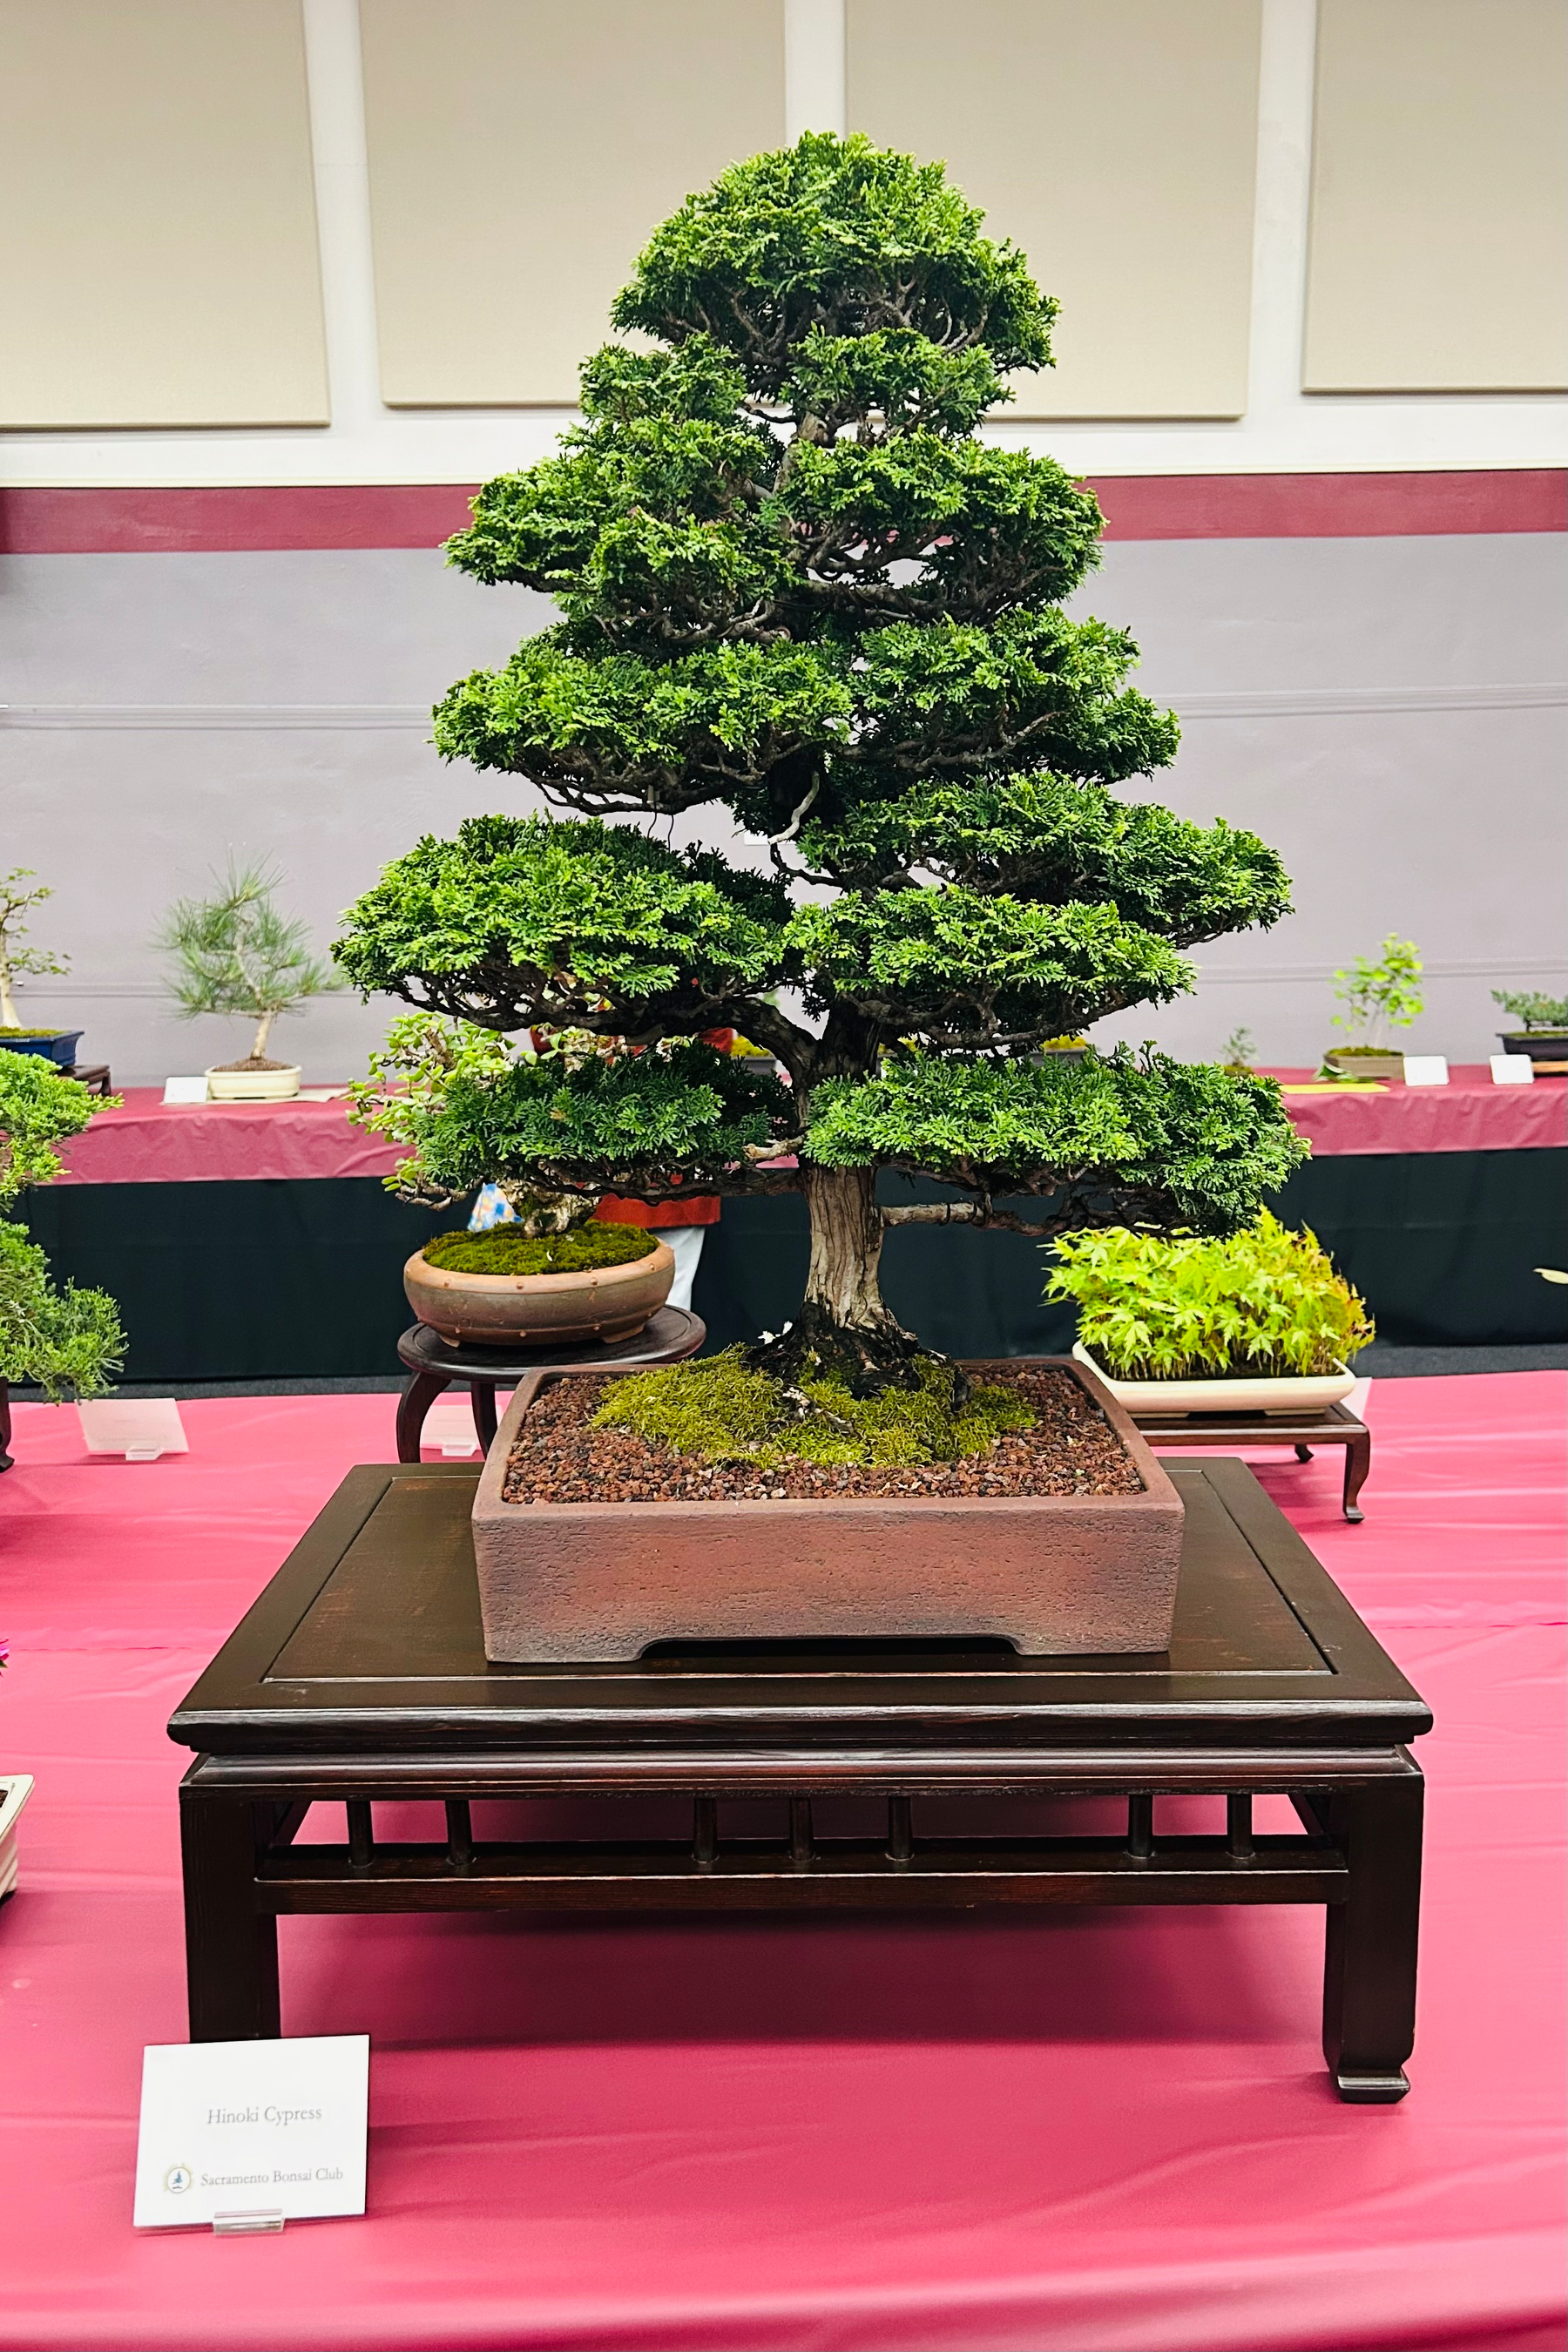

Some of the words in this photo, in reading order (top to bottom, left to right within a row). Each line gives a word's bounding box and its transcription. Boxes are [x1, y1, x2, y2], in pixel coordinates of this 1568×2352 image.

[206, 2106, 260, 2125] Hinoki
[264, 2105, 322, 2126] Cypress
[200, 2173, 270, 2186] Sacramento
[273, 2169, 313, 2182] Bonsai
[315, 2166, 344, 2180] Club
